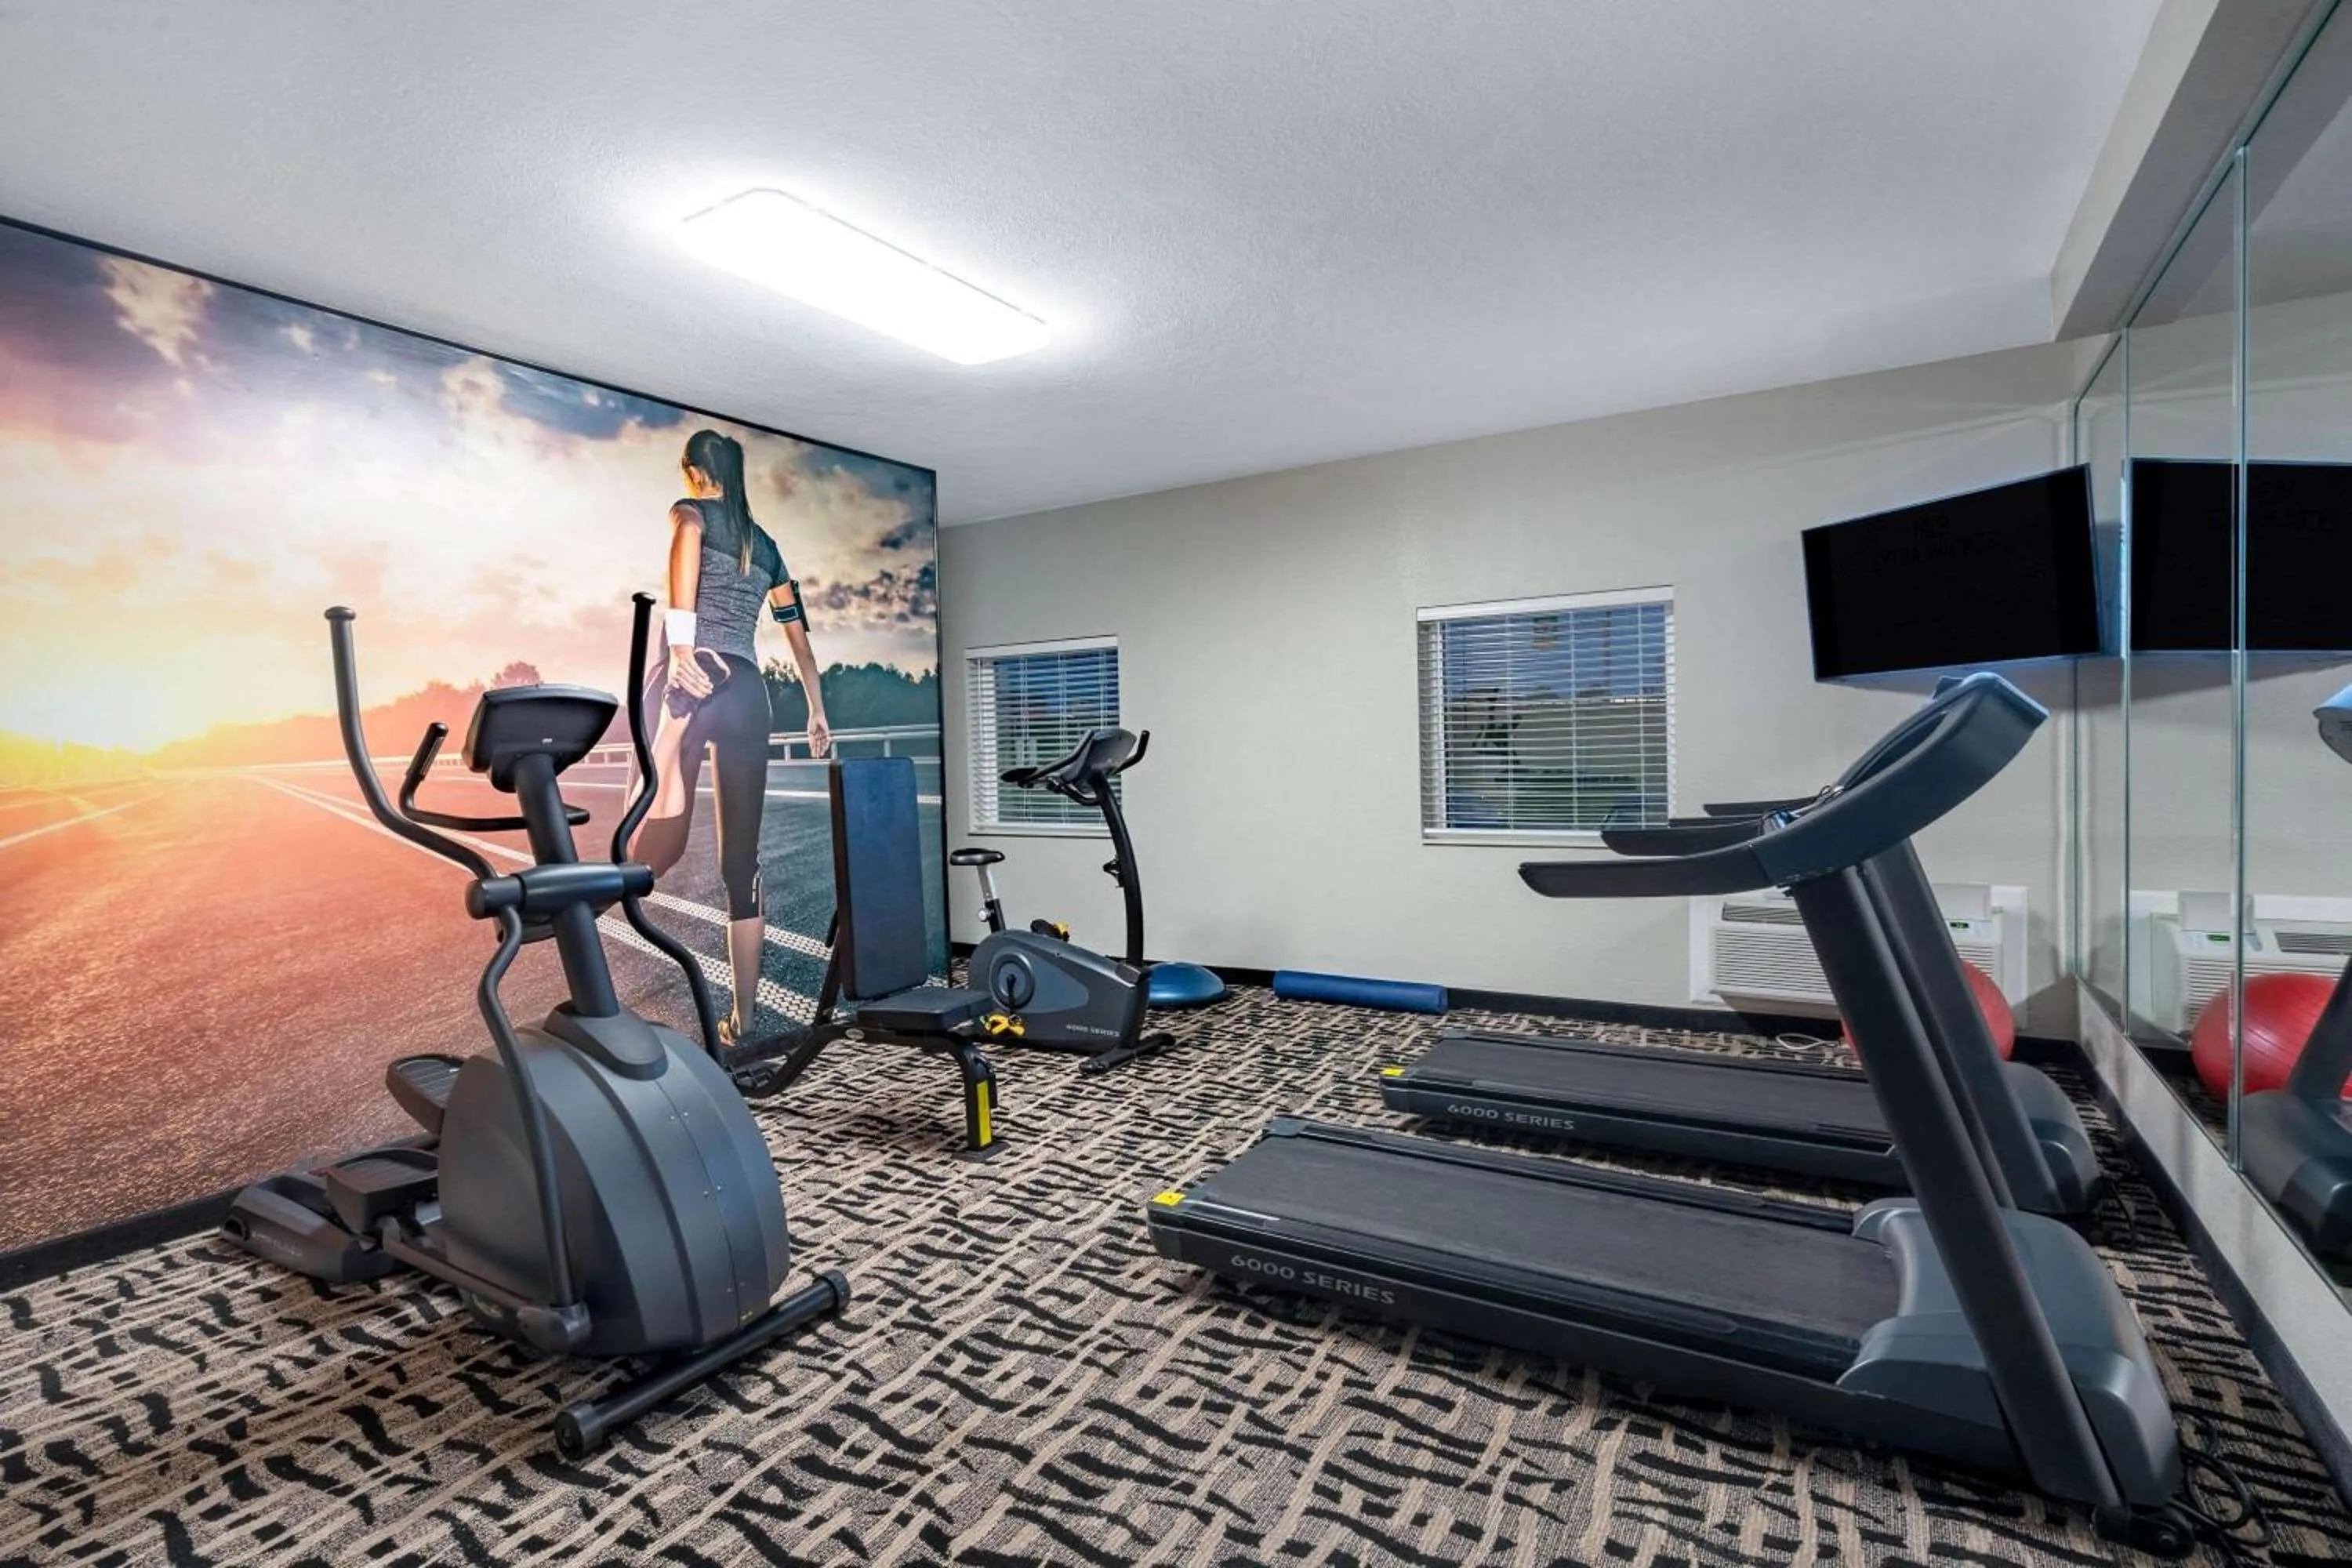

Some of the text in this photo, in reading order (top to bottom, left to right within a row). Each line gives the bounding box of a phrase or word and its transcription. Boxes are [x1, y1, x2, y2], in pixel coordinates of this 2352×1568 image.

[1447, 1104, 1575, 1131] 6000 SERIES
[1231, 1255, 1396, 1305] 6000 SERIES
